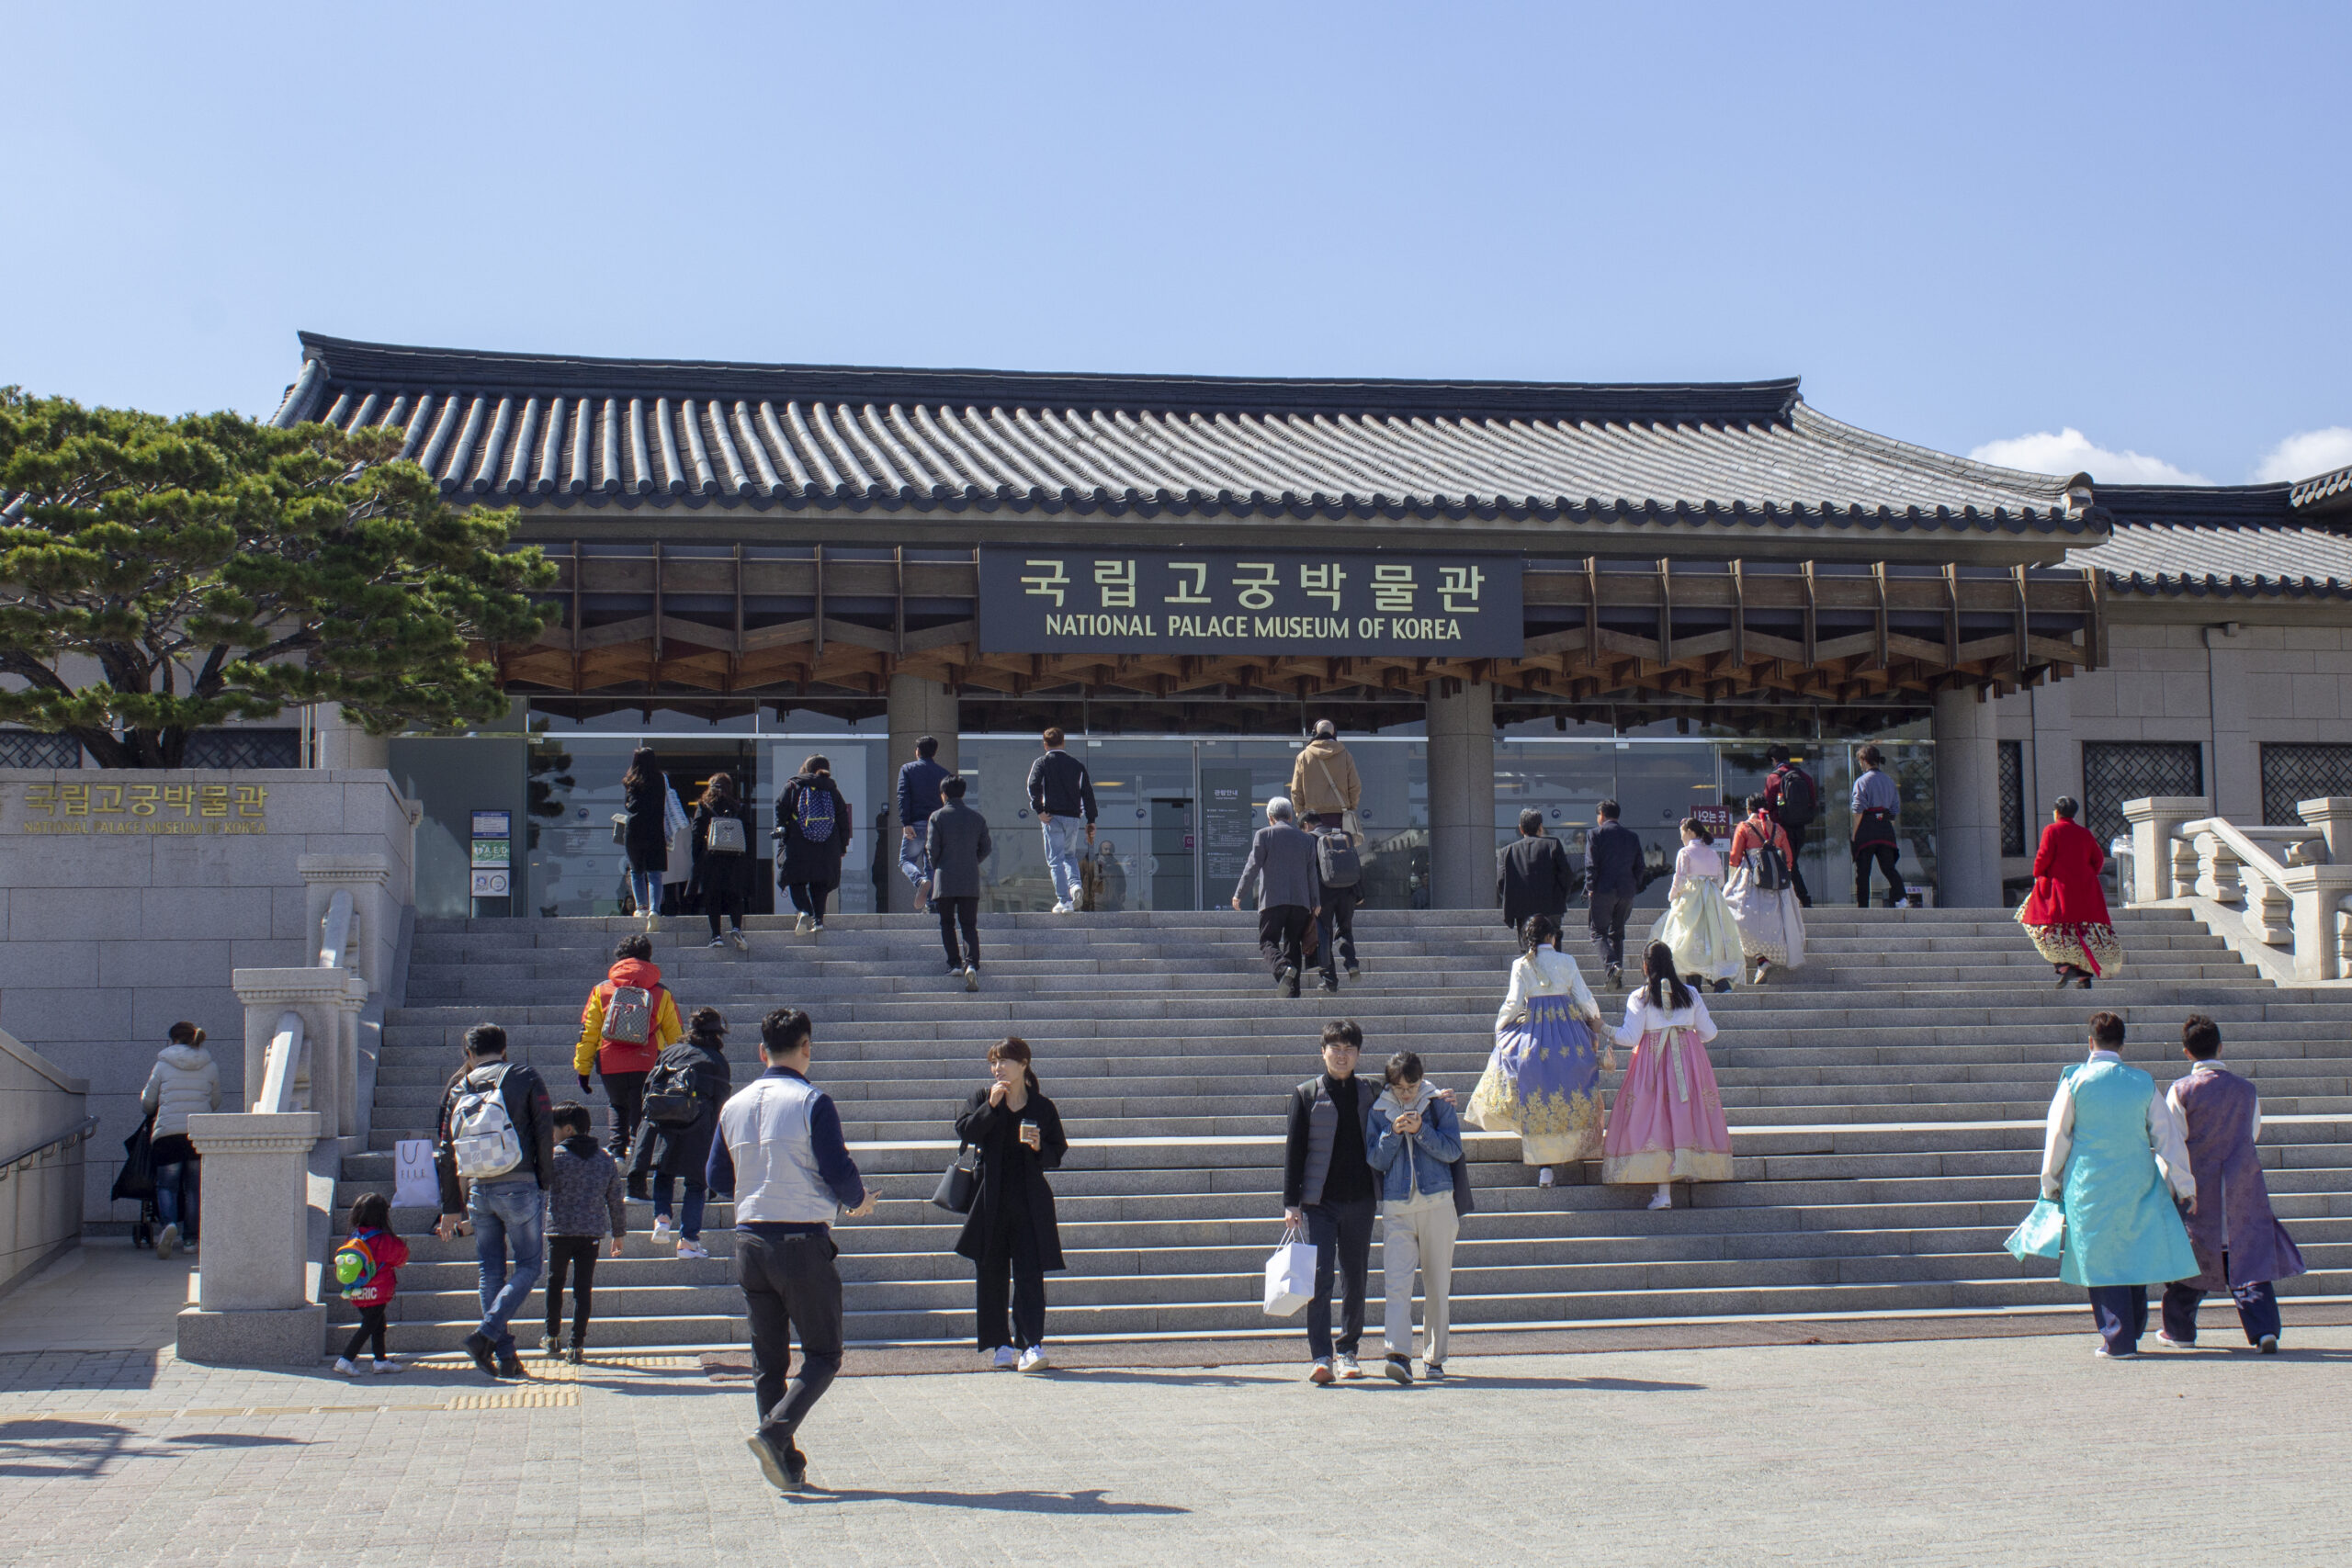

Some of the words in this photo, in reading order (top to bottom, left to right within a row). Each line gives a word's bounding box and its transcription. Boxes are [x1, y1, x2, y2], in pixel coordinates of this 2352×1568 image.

[1021, 559, 1485, 613] 국립고궁박물관
[1046, 614, 1157, 637] NATIONAL
[1168, 615, 1249, 637] PALACE
[1254, 616, 1350, 638] MUSEUM
[1358, 617, 1385, 638] OF
[1392, 617, 1462, 640] KOREA
[25, 784, 269, 817] 국립고궁박물관
[1718, 810, 1726, 823] 곳
[24, 820, 89, 833] NATIONAL
[95, 820, 141, 833] PALACE
[145, 821, 201, 833] MUSEUM
[206, 821, 221, 834] OF
[224, 821, 266, 834] KOREA
[484, 845, 507, 854] AED
